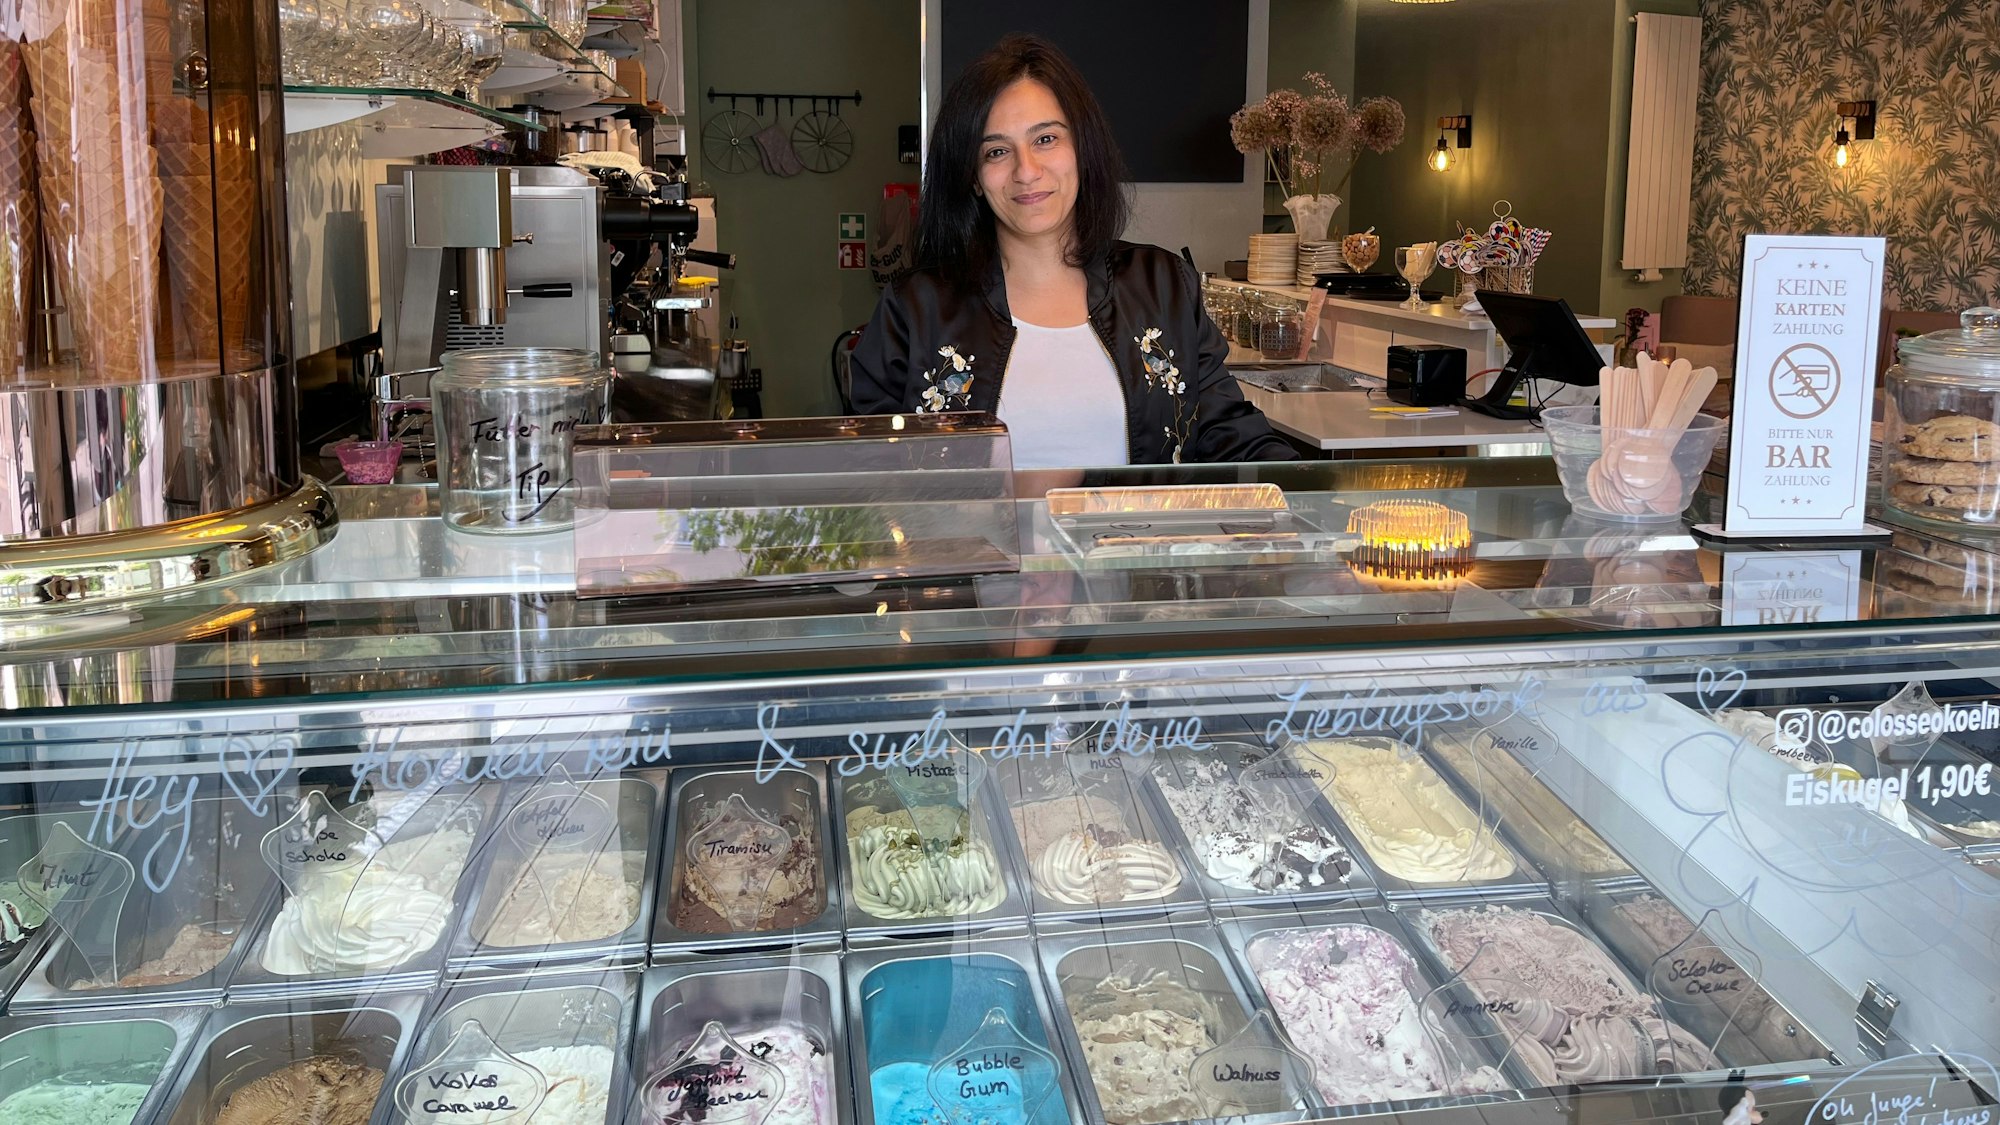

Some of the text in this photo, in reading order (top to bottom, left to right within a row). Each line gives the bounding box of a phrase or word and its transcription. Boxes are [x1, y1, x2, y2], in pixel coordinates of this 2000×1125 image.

[1776, 278, 1847, 296] KEINE
[1774, 302, 1846, 316] KARTEN
[1772, 323, 1844, 335] ZAHLUNG
[1768, 428, 1834, 439] BITTE NUR
[1765, 444, 1832, 468] BAR
[504, 462, 551, 504] Tip
[1764, 475, 1831, 486] ZAHLUNG
[1817, 700, 1999, 744] @colosseokoeln
[1490, 735, 1540, 752] Vanille
[79, 745, 199, 893] Hey
[756, 704, 806, 784] &
[838, 708, 950, 777] such
[1099, 700, 1212, 756] deine
[1582, 677, 1648, 717] aus
[1785, 763, 1993, 811] Eiskugel 1,90€
[285, 848, 347, 864] Schoko
[703, 839, 773, 858] Tiramisu
[1668, 958, 1736, 982] Schoko-
[1686, 979, 1742, 995] Creme
[955, 1052, 1025, 1076] Bubble
[1212, 1063, 1281, 1082] Walnuss
[959, 1079, 1010, 1099] Gum
